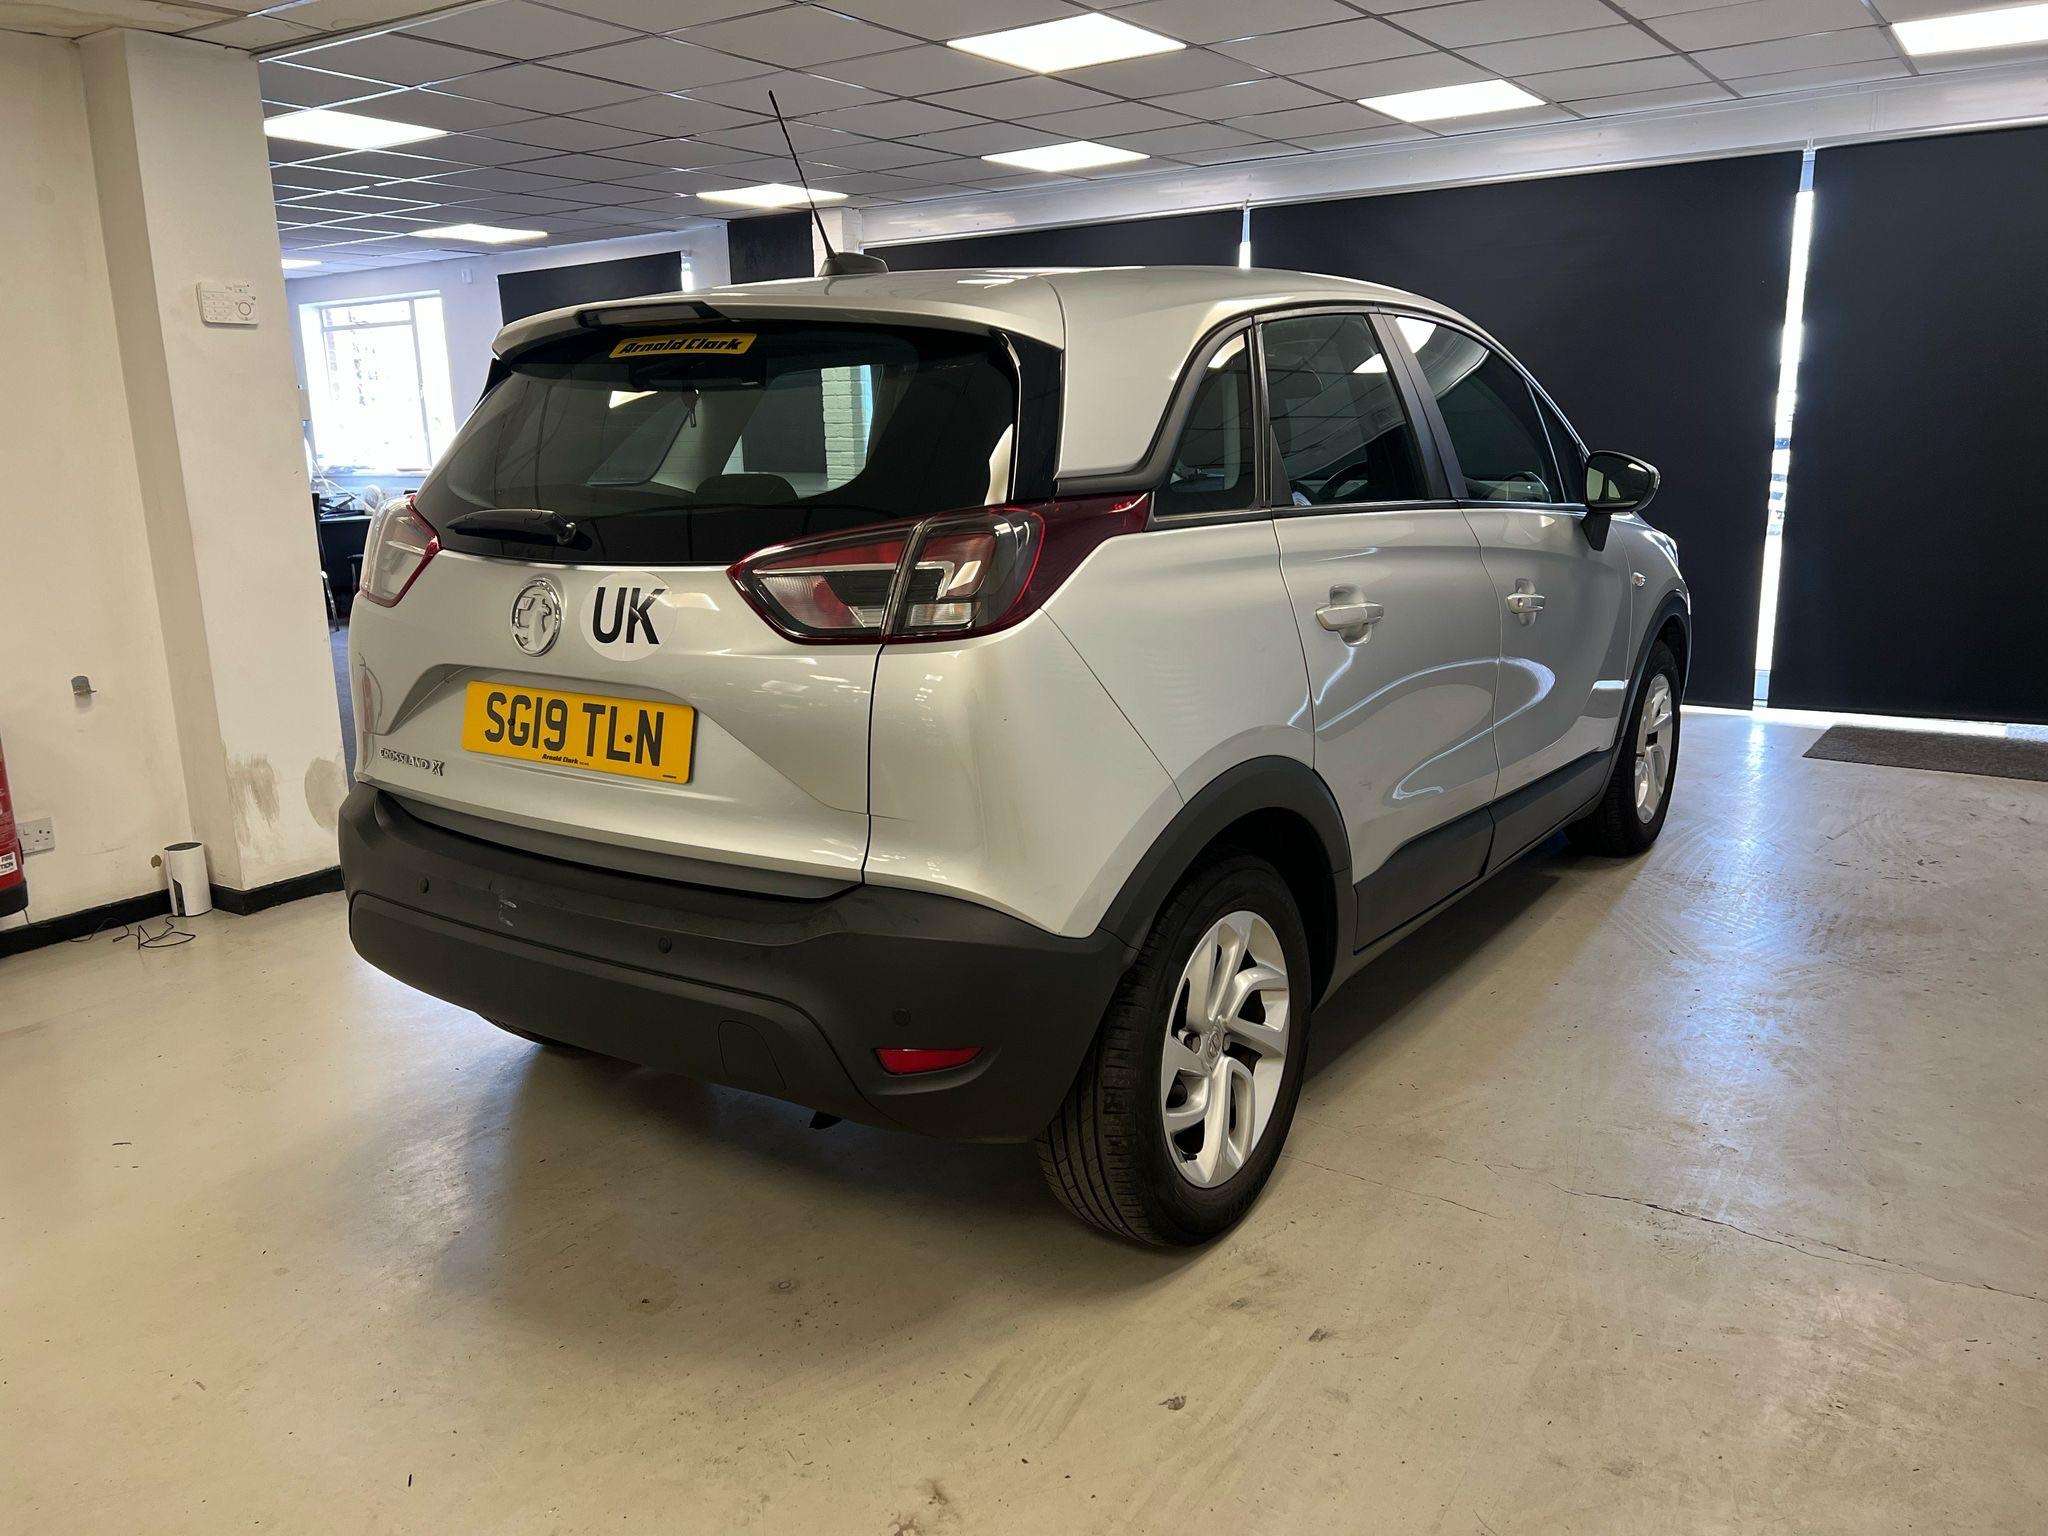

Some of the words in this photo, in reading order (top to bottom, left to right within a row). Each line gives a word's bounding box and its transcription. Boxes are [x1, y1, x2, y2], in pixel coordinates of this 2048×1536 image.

[619, 339, 684, 354] Arnold
[686, 338, 743, 350] Clark
[592, 587, 666, 645] UK
[484, 691, 569, 752] SG19
[582, 702, 664, 767] TLN
[379, 747, 431, 770] CROSSLAND
[541, 753, 562, 762] Arnold
[562, 754, 579, 765] Clark
